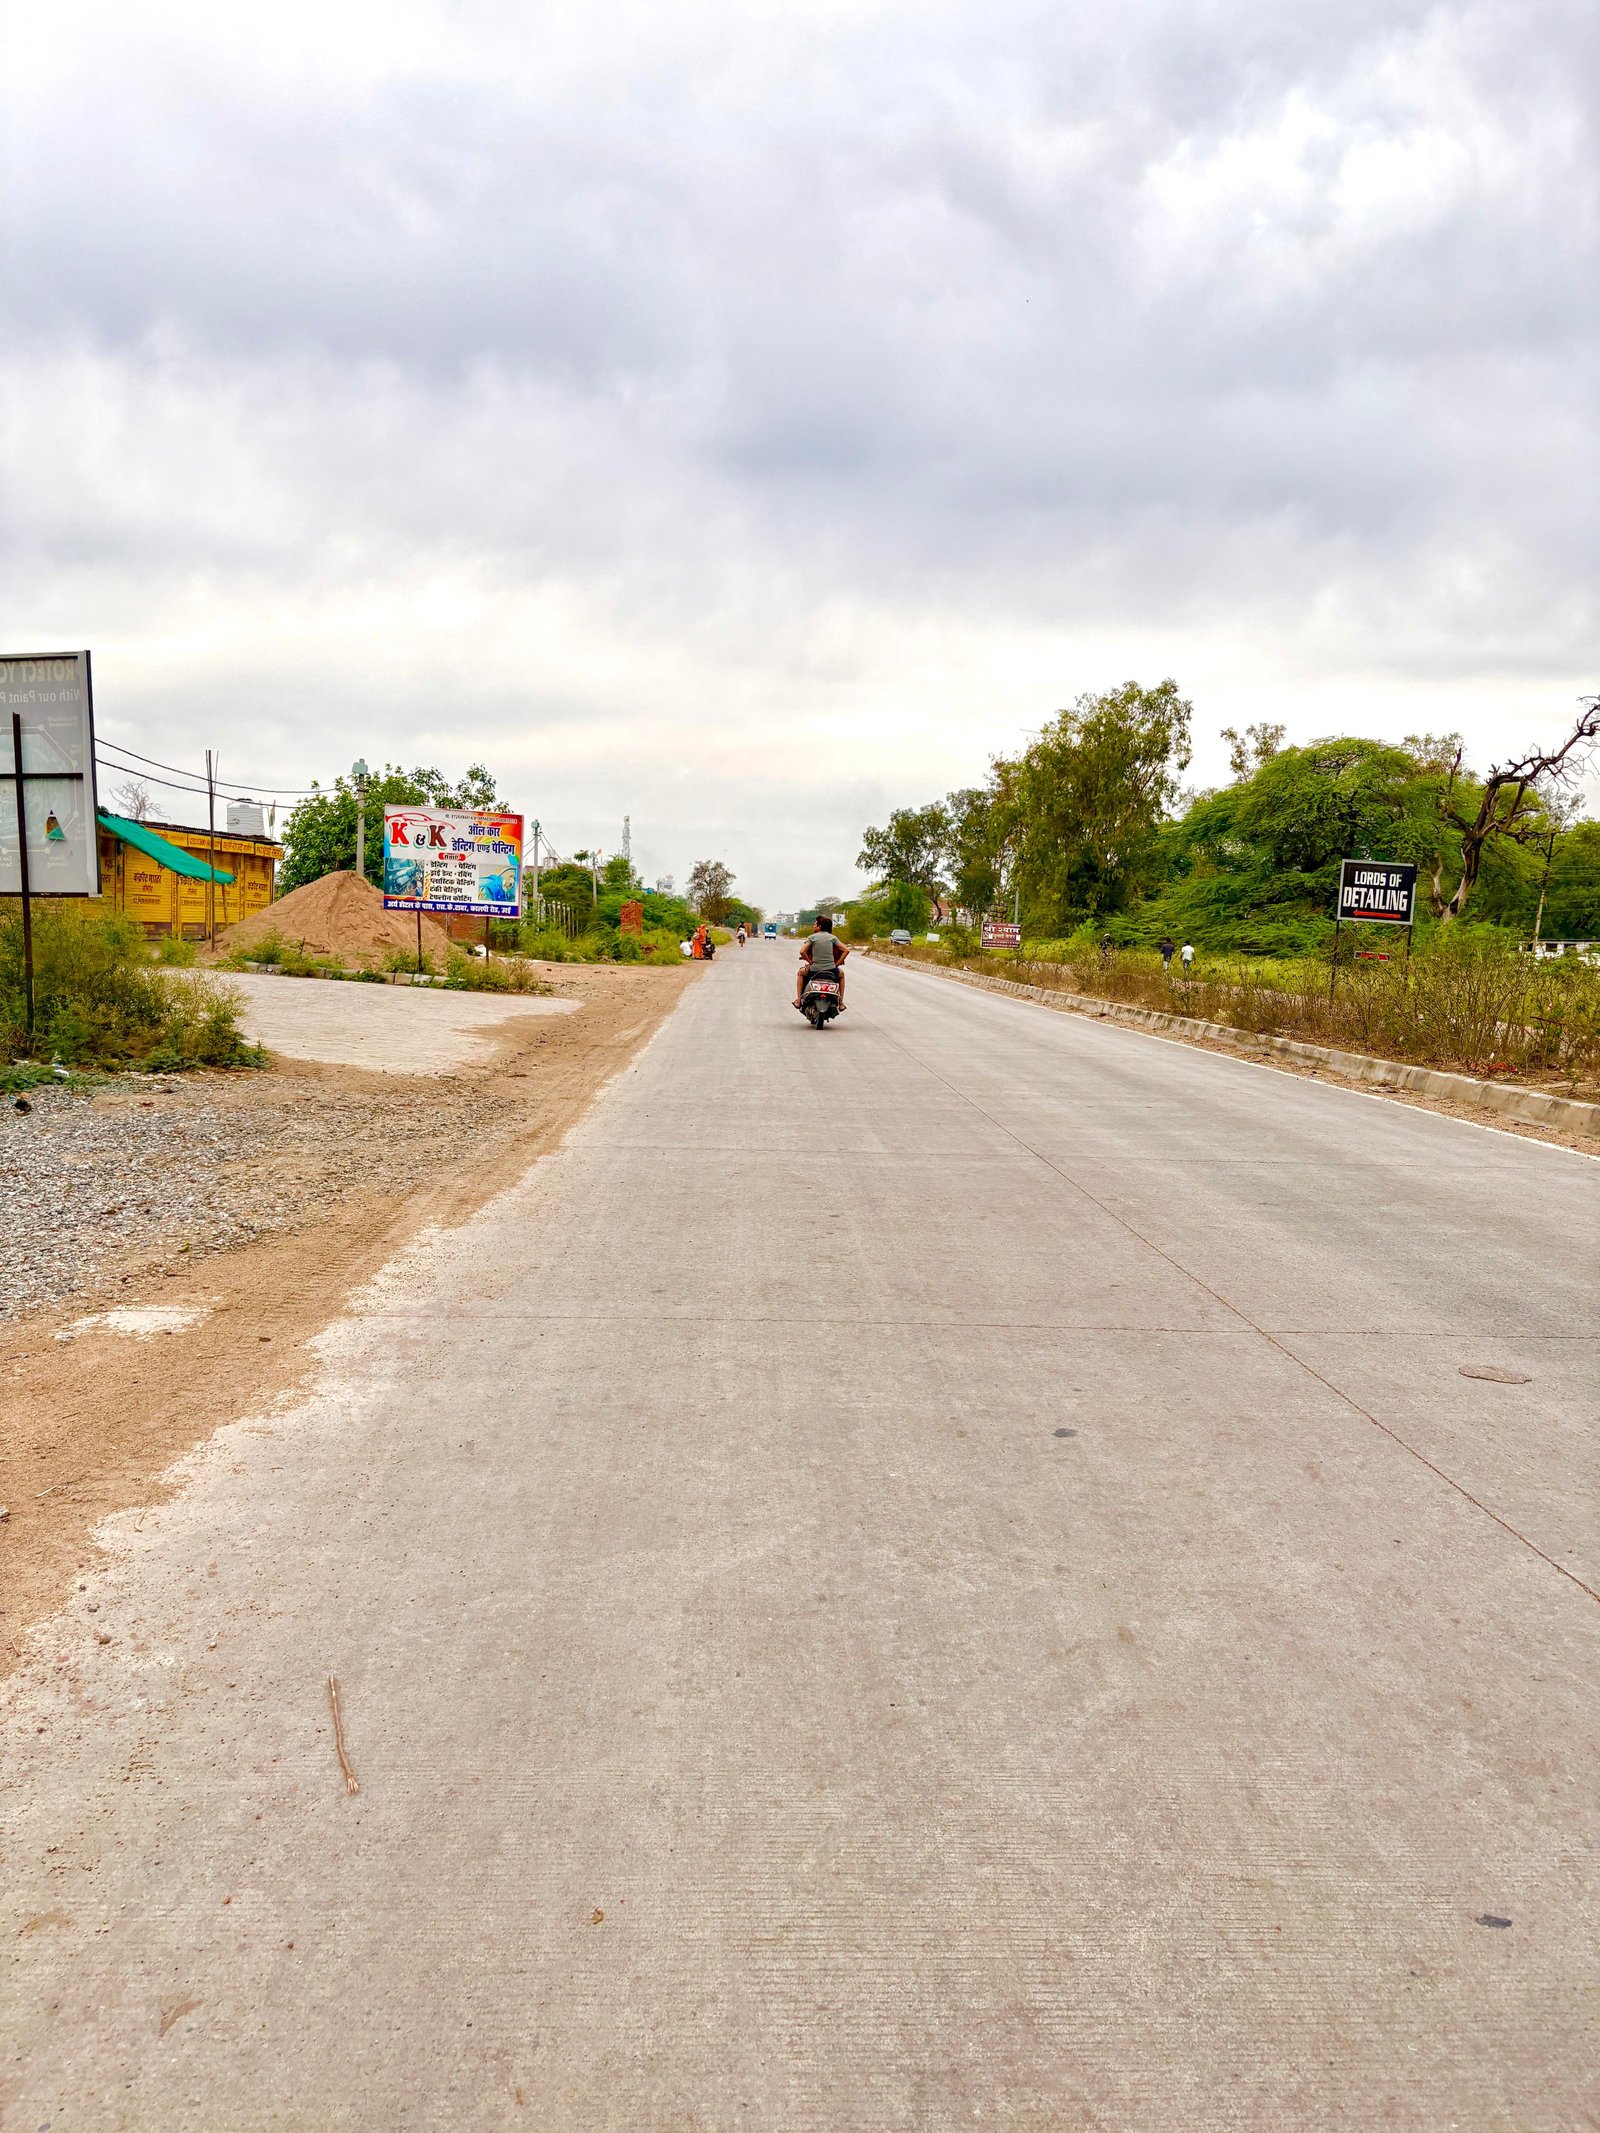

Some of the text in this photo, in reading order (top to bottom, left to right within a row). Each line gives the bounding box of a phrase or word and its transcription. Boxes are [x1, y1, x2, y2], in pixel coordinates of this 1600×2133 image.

[391, 822, 447, 847] K & K
[1354, 870, 1402, 888] LORDS OF
[1342, 886, 1408, 911] DETAILING
